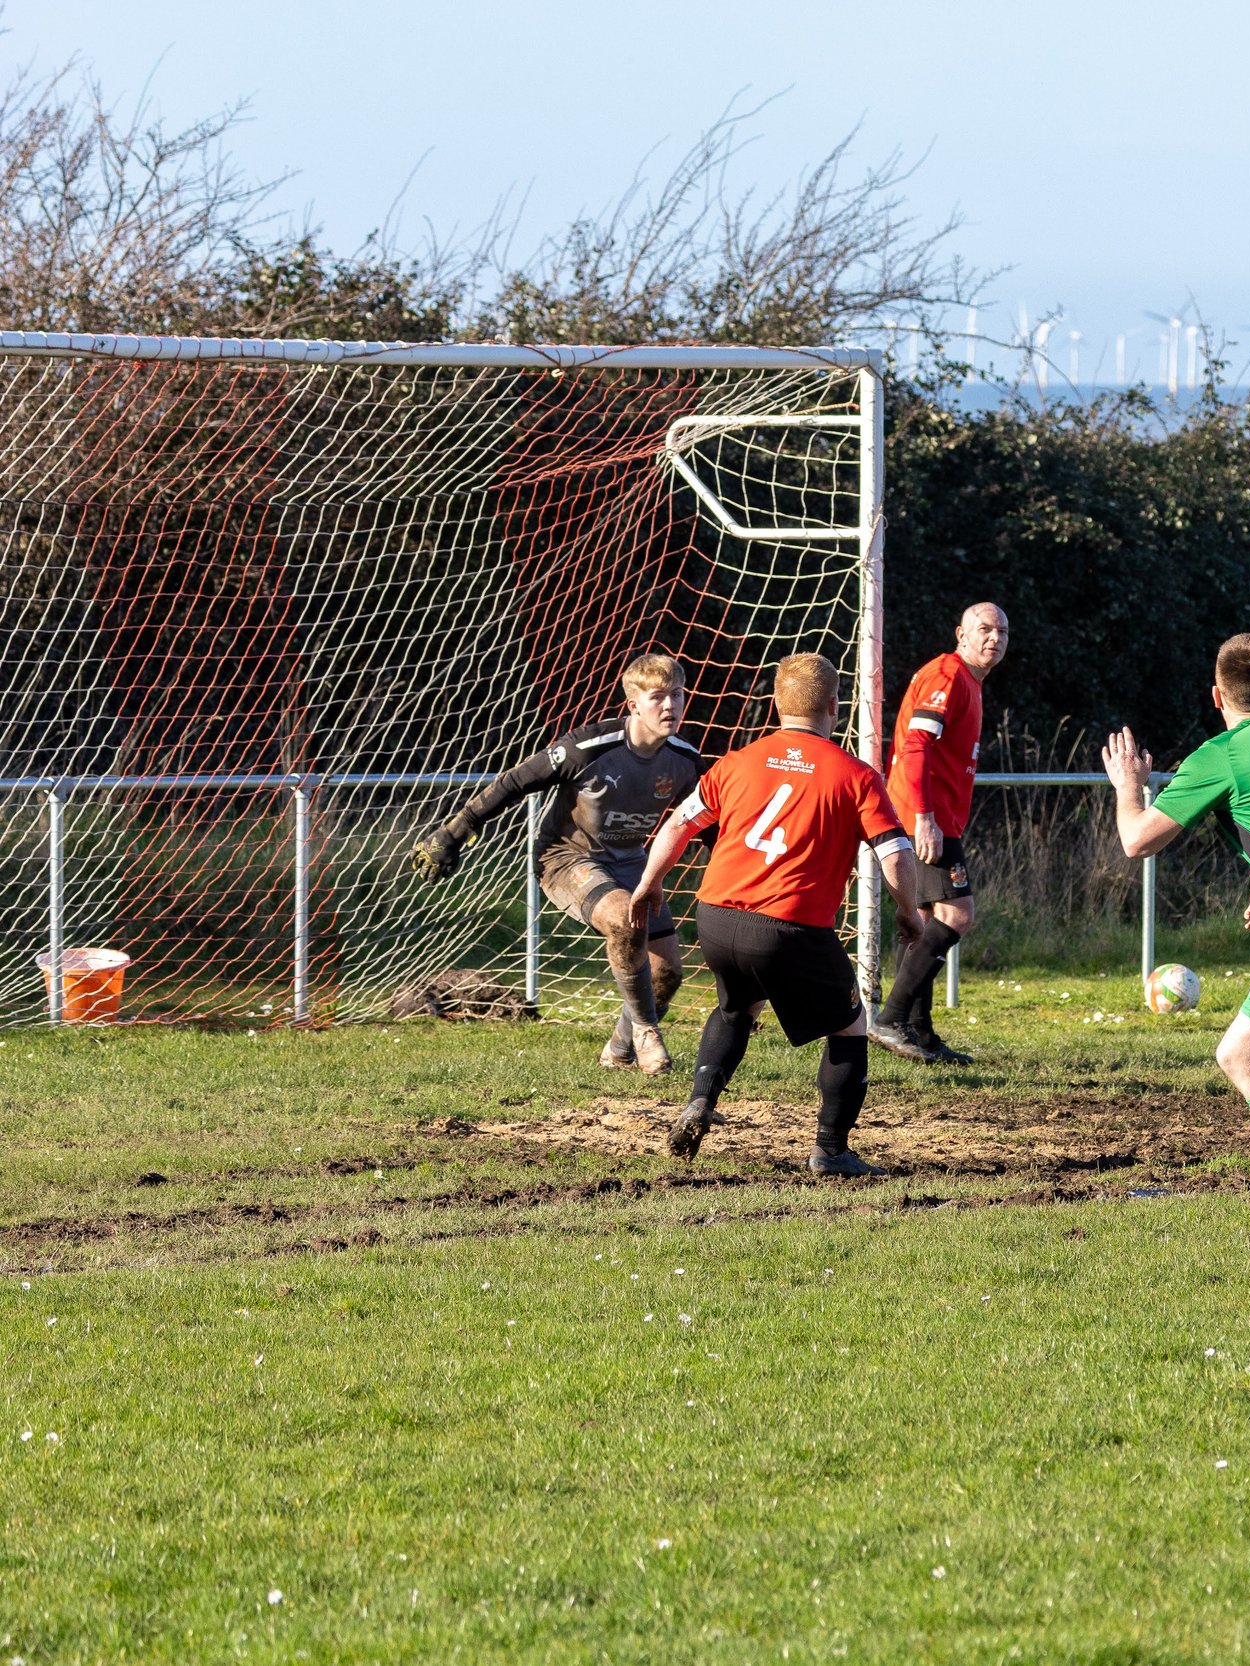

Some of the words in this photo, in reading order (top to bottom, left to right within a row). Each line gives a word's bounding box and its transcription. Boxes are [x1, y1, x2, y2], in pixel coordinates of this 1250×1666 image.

[765, 763, 790, 772] cleaning
[767, 756, 779, 764] RG
[780, 759, 816, 769] HOWELLS
[604, 810, 660, 829] PSS
[744, 783, 788, 865] 4
[597, 831, 620, 841] AUTO
